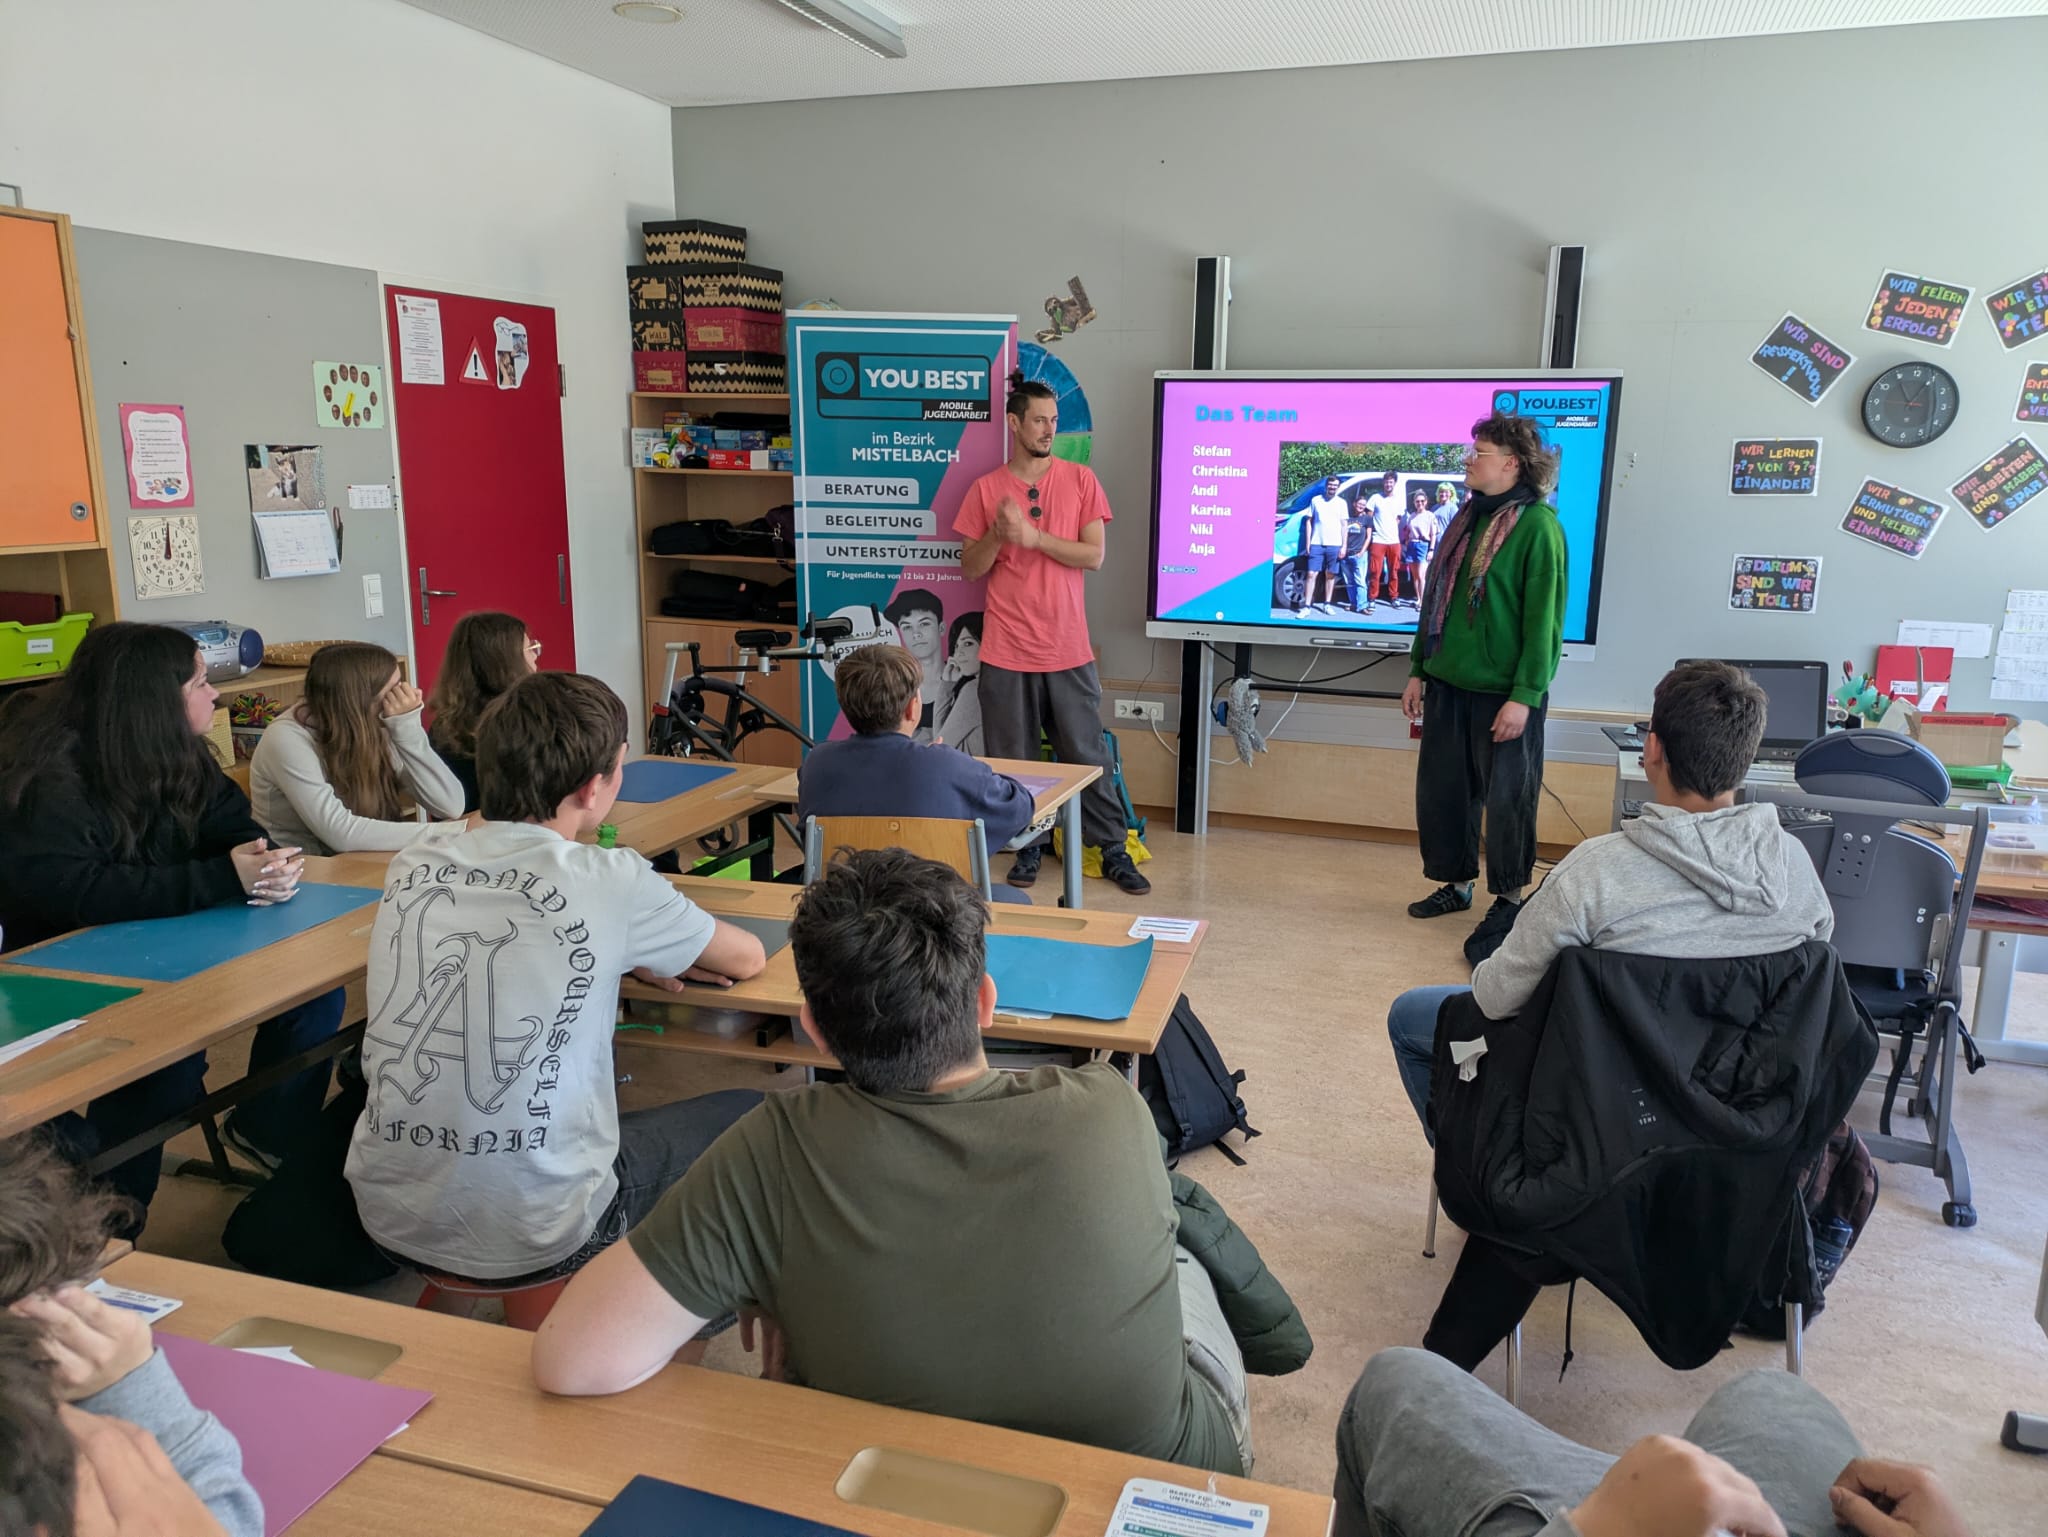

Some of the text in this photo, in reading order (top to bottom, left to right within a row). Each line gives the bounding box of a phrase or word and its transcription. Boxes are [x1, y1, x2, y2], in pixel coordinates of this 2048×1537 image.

[1890, 278, 1965, 304] WIR FEIERN
[1993, 290, 2026, 311] WIR
[1894, 296, 1948, 319] JEDEN
[1784, 320, 1845, 369] WIR SIND
[939, 402, 973, 410] MOBILE
[1522, 398, 1597, 410] YOU.BEST
[923, 410, 989, 420] JUGENDARBEIT
[1196, 405, 1297, 422] Das Team
[872, 432, 935, 446] im Bezirk
[852, 448, 960, 463] MISTELBACH
[1193, 445, 1231, 457] Stefan
[1740, 445, 1814, 459] WIR LERNEN
[1192, 465, 1248, 477] Christina
[1757, 462, 1783, 472] VON
[1734, 476, 1811, 490] EINANDER
[1971, 450, 2034, 503] ARBEITEN
[825, 483, 909, 497] BERATUNG
[1191, 484, 1218, 496] Andi
[1867, 483, 1891, 499] WIR
[1954, 476, 1980, 496] WIR
[1972, 460, 2044, 514] UND HABEN
[1191, 504, 1231, 516] Karina
[1860, 494, 1930, 528] ERMUTIGEN
[825, 515, 922, 528] BEGLEITUNG
[1853, 506, 1920, 536] UND HELFEN
[151, 531, 157, 539] 11
[1190, 524, 1213, 535] Niki
[1848, 518, 1914, 551] EINANDER
[143, 541, 151, 550] 10
[182, 539, 187, 547] 2
[1189, 543, 1215, 555] Anja
[142, 554, 148, 562] 9
[187, 551, 192, 559] 3
[826, 545, 963, 560] UNTERSTÜTZUNG
[146, 566, 151, 574] 8
[1753, 559, 1802, 574] DARUM
[155, 575, 160, 583] 7
[827, 570, 840, 579] Für
[842, 571, 885, 580] Jugendliche
[168, 578, 173, 586] 6
[1736, 575, 1812, 591] SIND WIR
